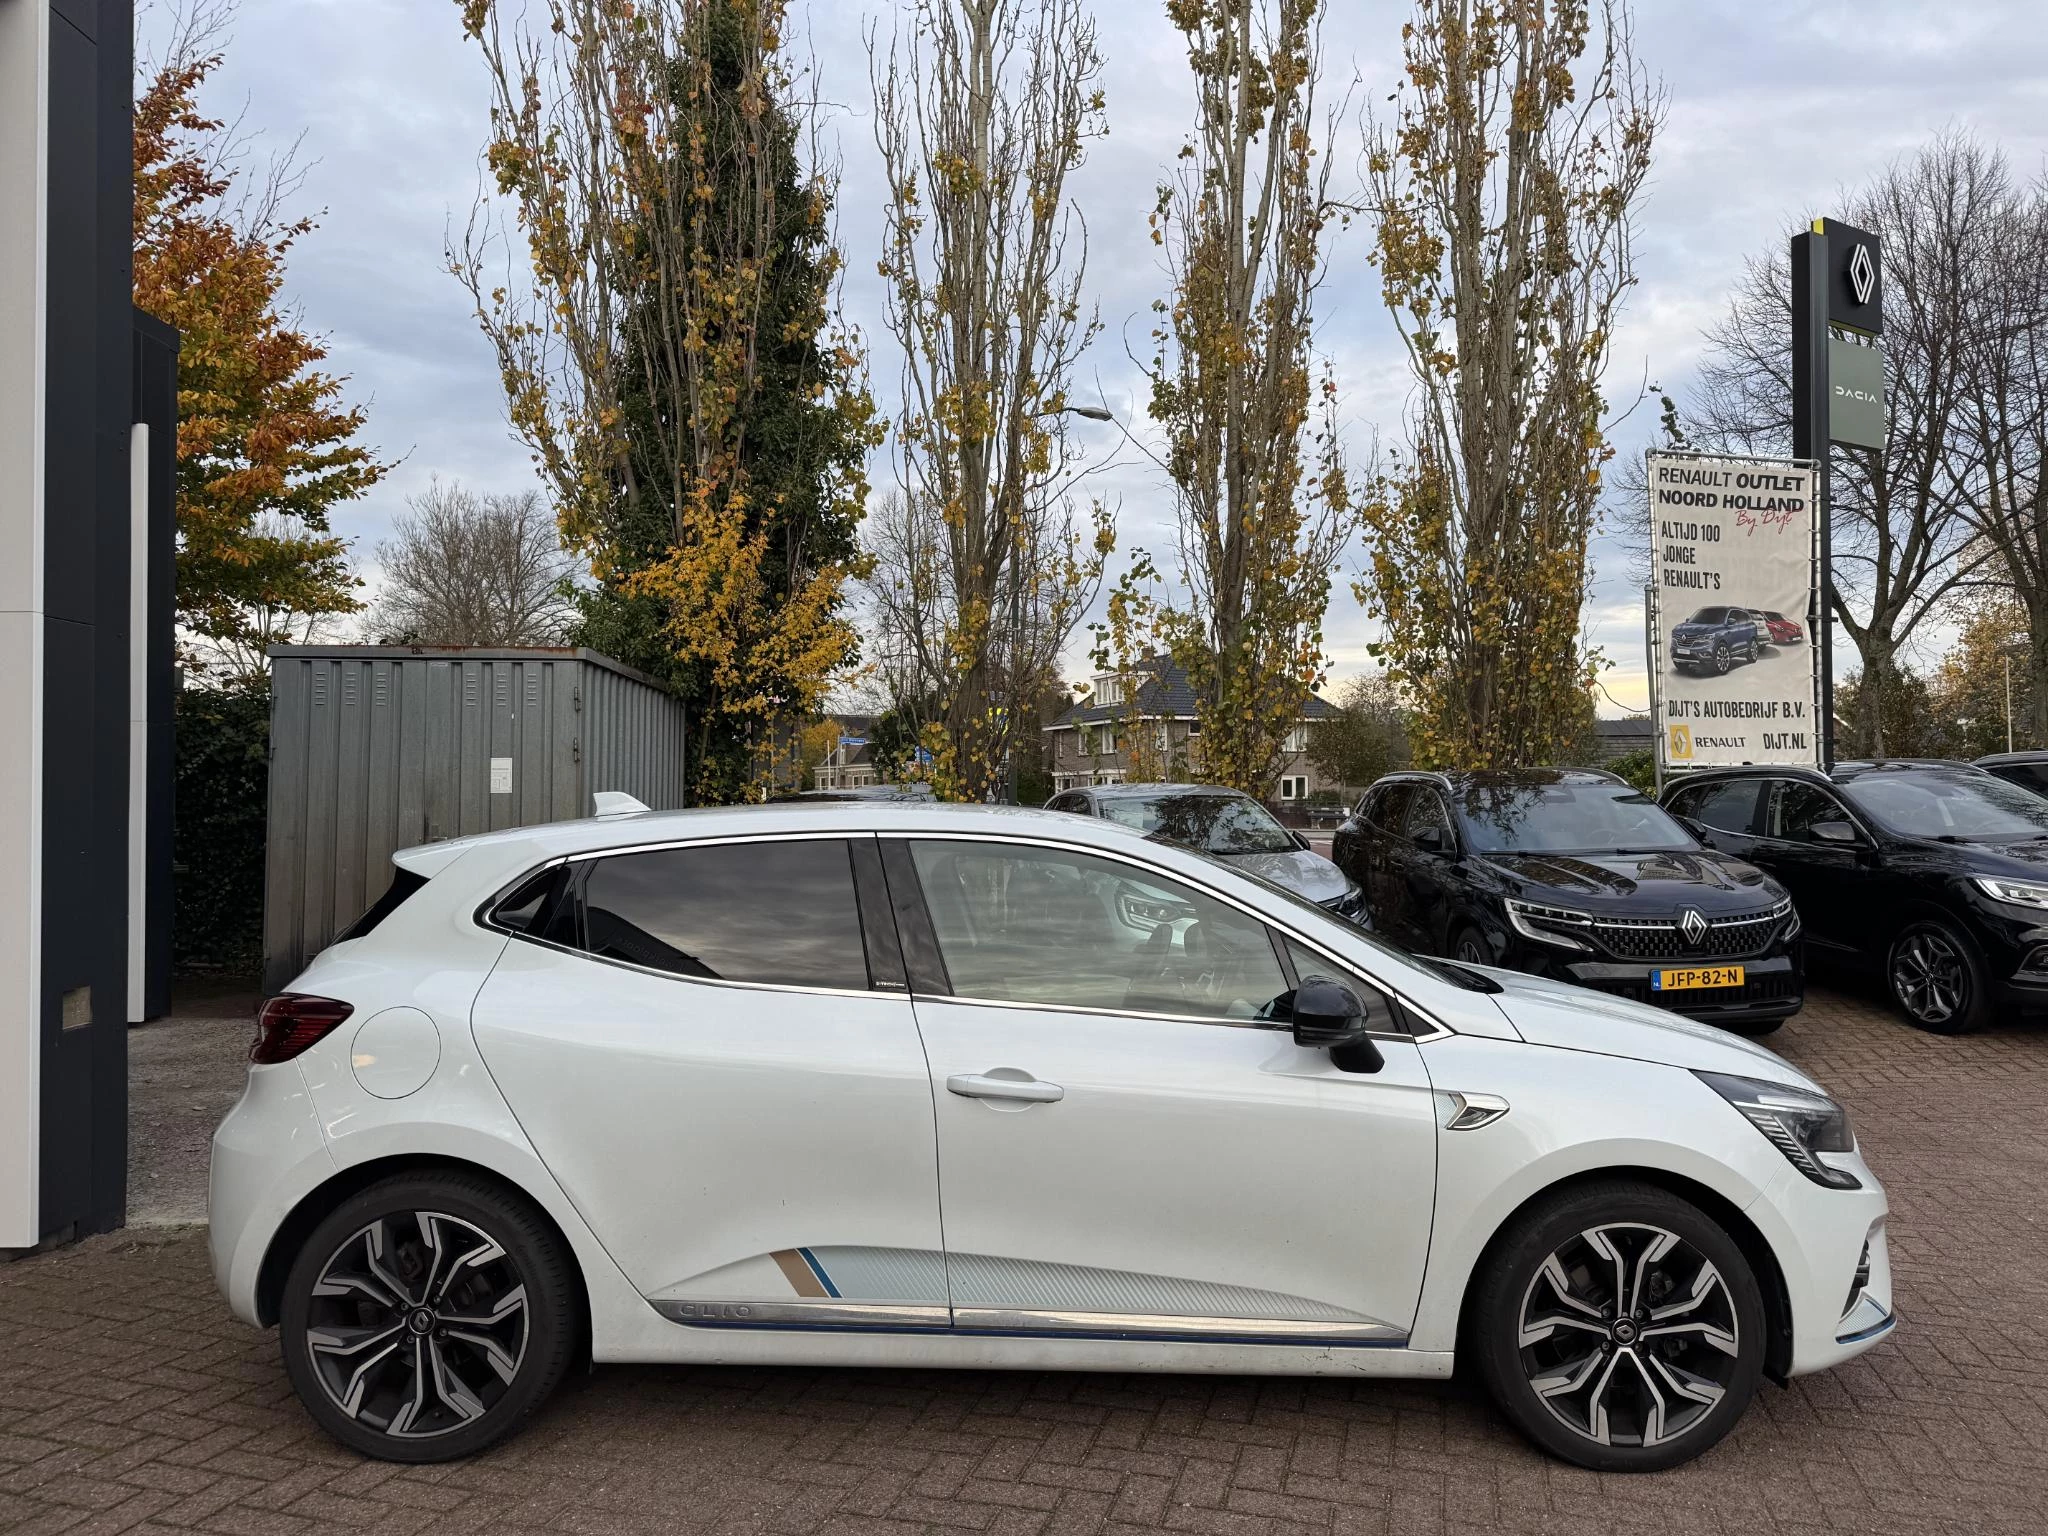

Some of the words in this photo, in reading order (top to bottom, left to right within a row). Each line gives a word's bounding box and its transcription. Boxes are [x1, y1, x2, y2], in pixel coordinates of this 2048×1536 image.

[1658, 467, 1732, 488] RENAULT
[1736, 473, 1805, 492] OUTLET
[1658, 489, 1718, 508] NOORD
[1722, 494, 1805, 513] HOLLAND
[1661, 520, 1698, 541] ALTIJD
[1701, 523, 1721, 542] 100
[1735, 509, 1758, 536] By
[1663, 545, 1696, 565] JONGE
[1663, 568, 1721, 590] RENAULT'S
[1668, 700, 1700, 718] DIJT'S
[1703, 701, 1778, 719] AUTOBEDRIJF
[1782, 701, 1806, 719] B.V.
[1695, 736, 1747, 748] RENAULT
[1763, 732, 1807, 750] DIJT.NL
[1668, 969, 1738, 987] JFP-82-N
[680, 1304, 751, 1318] CLIO
